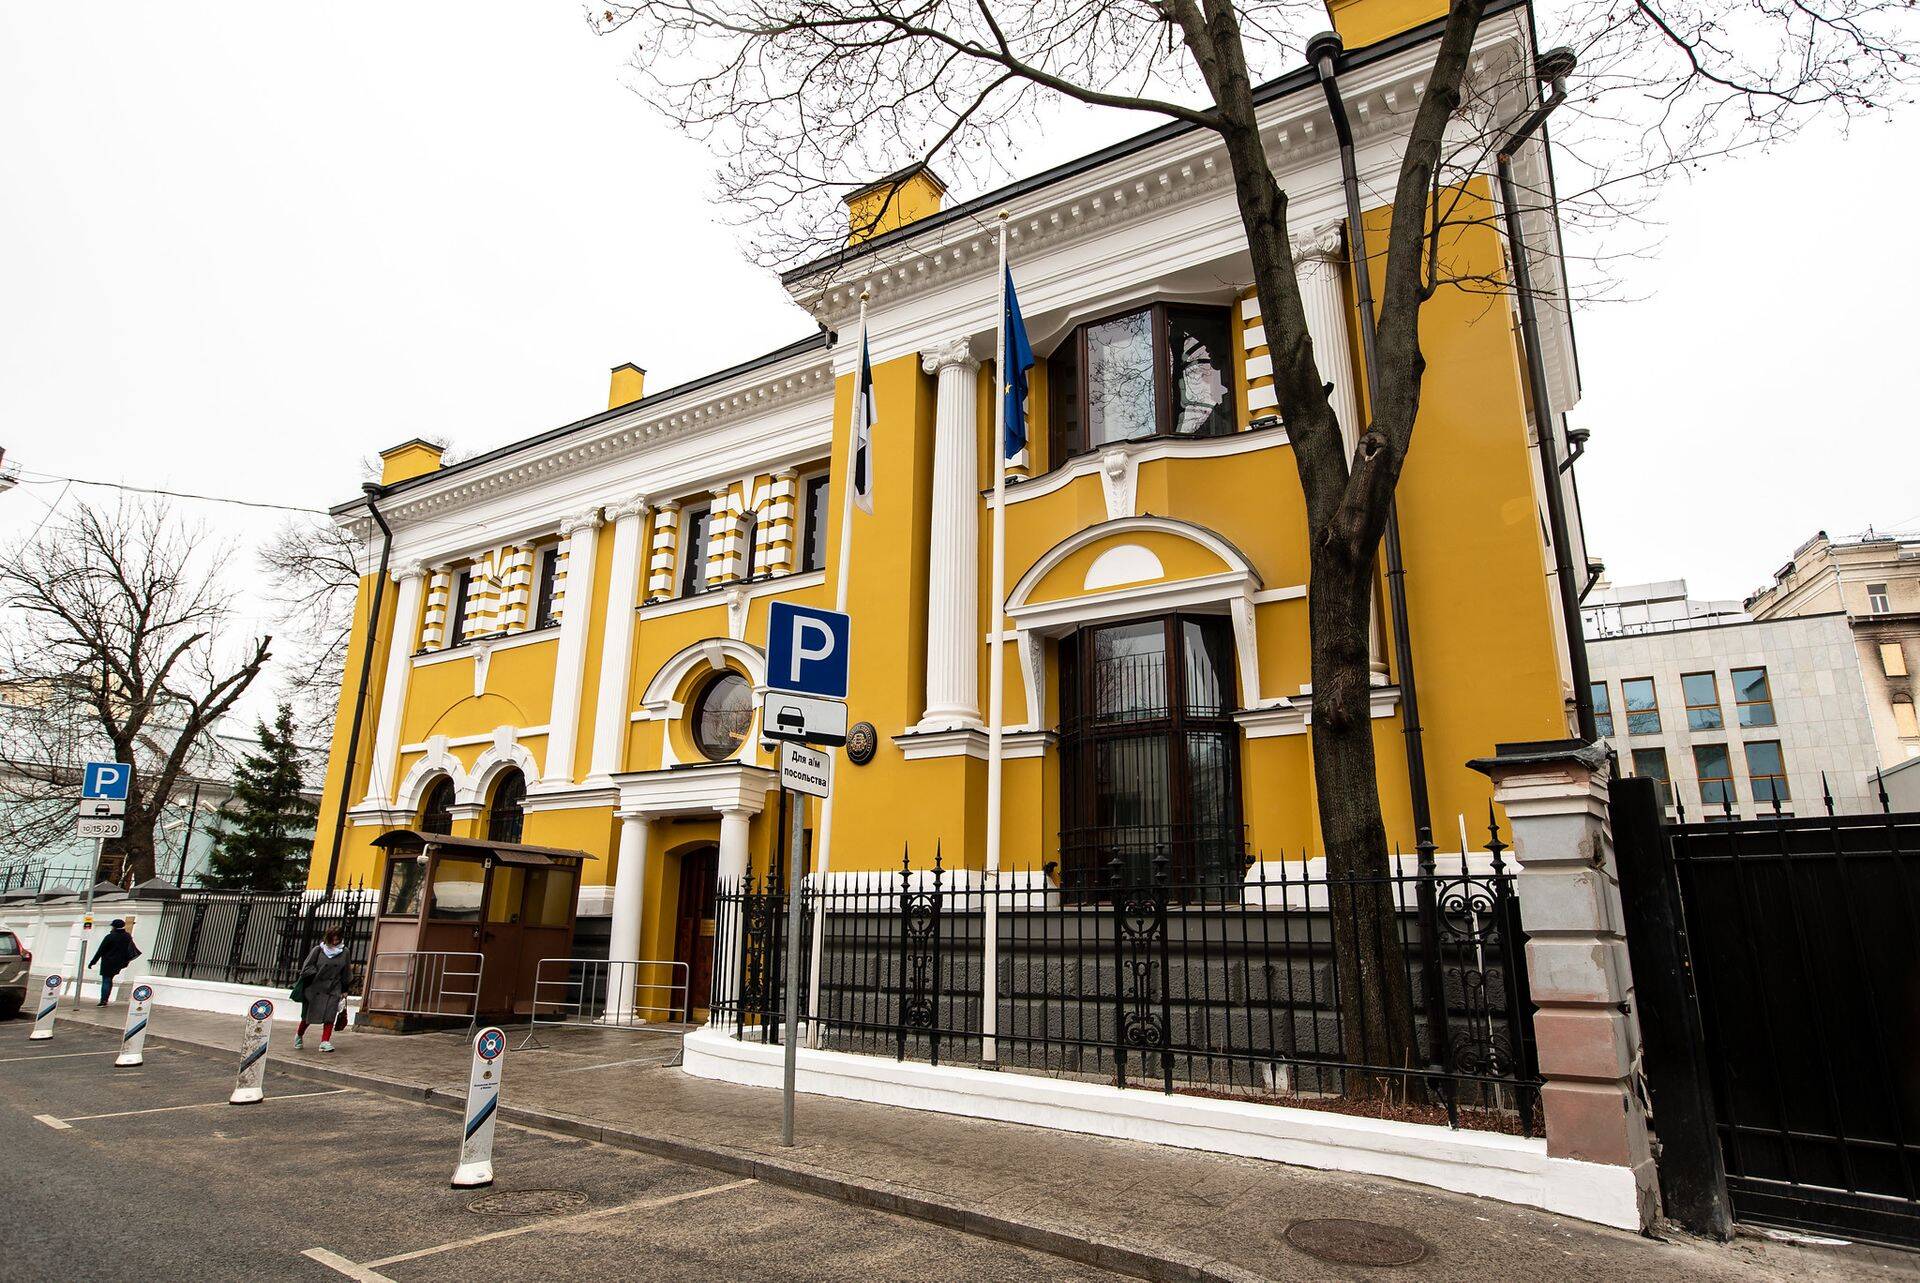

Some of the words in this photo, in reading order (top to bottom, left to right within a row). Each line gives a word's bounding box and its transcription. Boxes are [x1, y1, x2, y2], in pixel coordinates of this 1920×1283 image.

[790, 614, 835, 683] P
[792, 750, 807, 764] Для
[808, 757, 821, 769] а/м
[95, 767, 120, 794] P
[784, 768, 827, 787] посольства
[104, 825, 118, 833] 20
